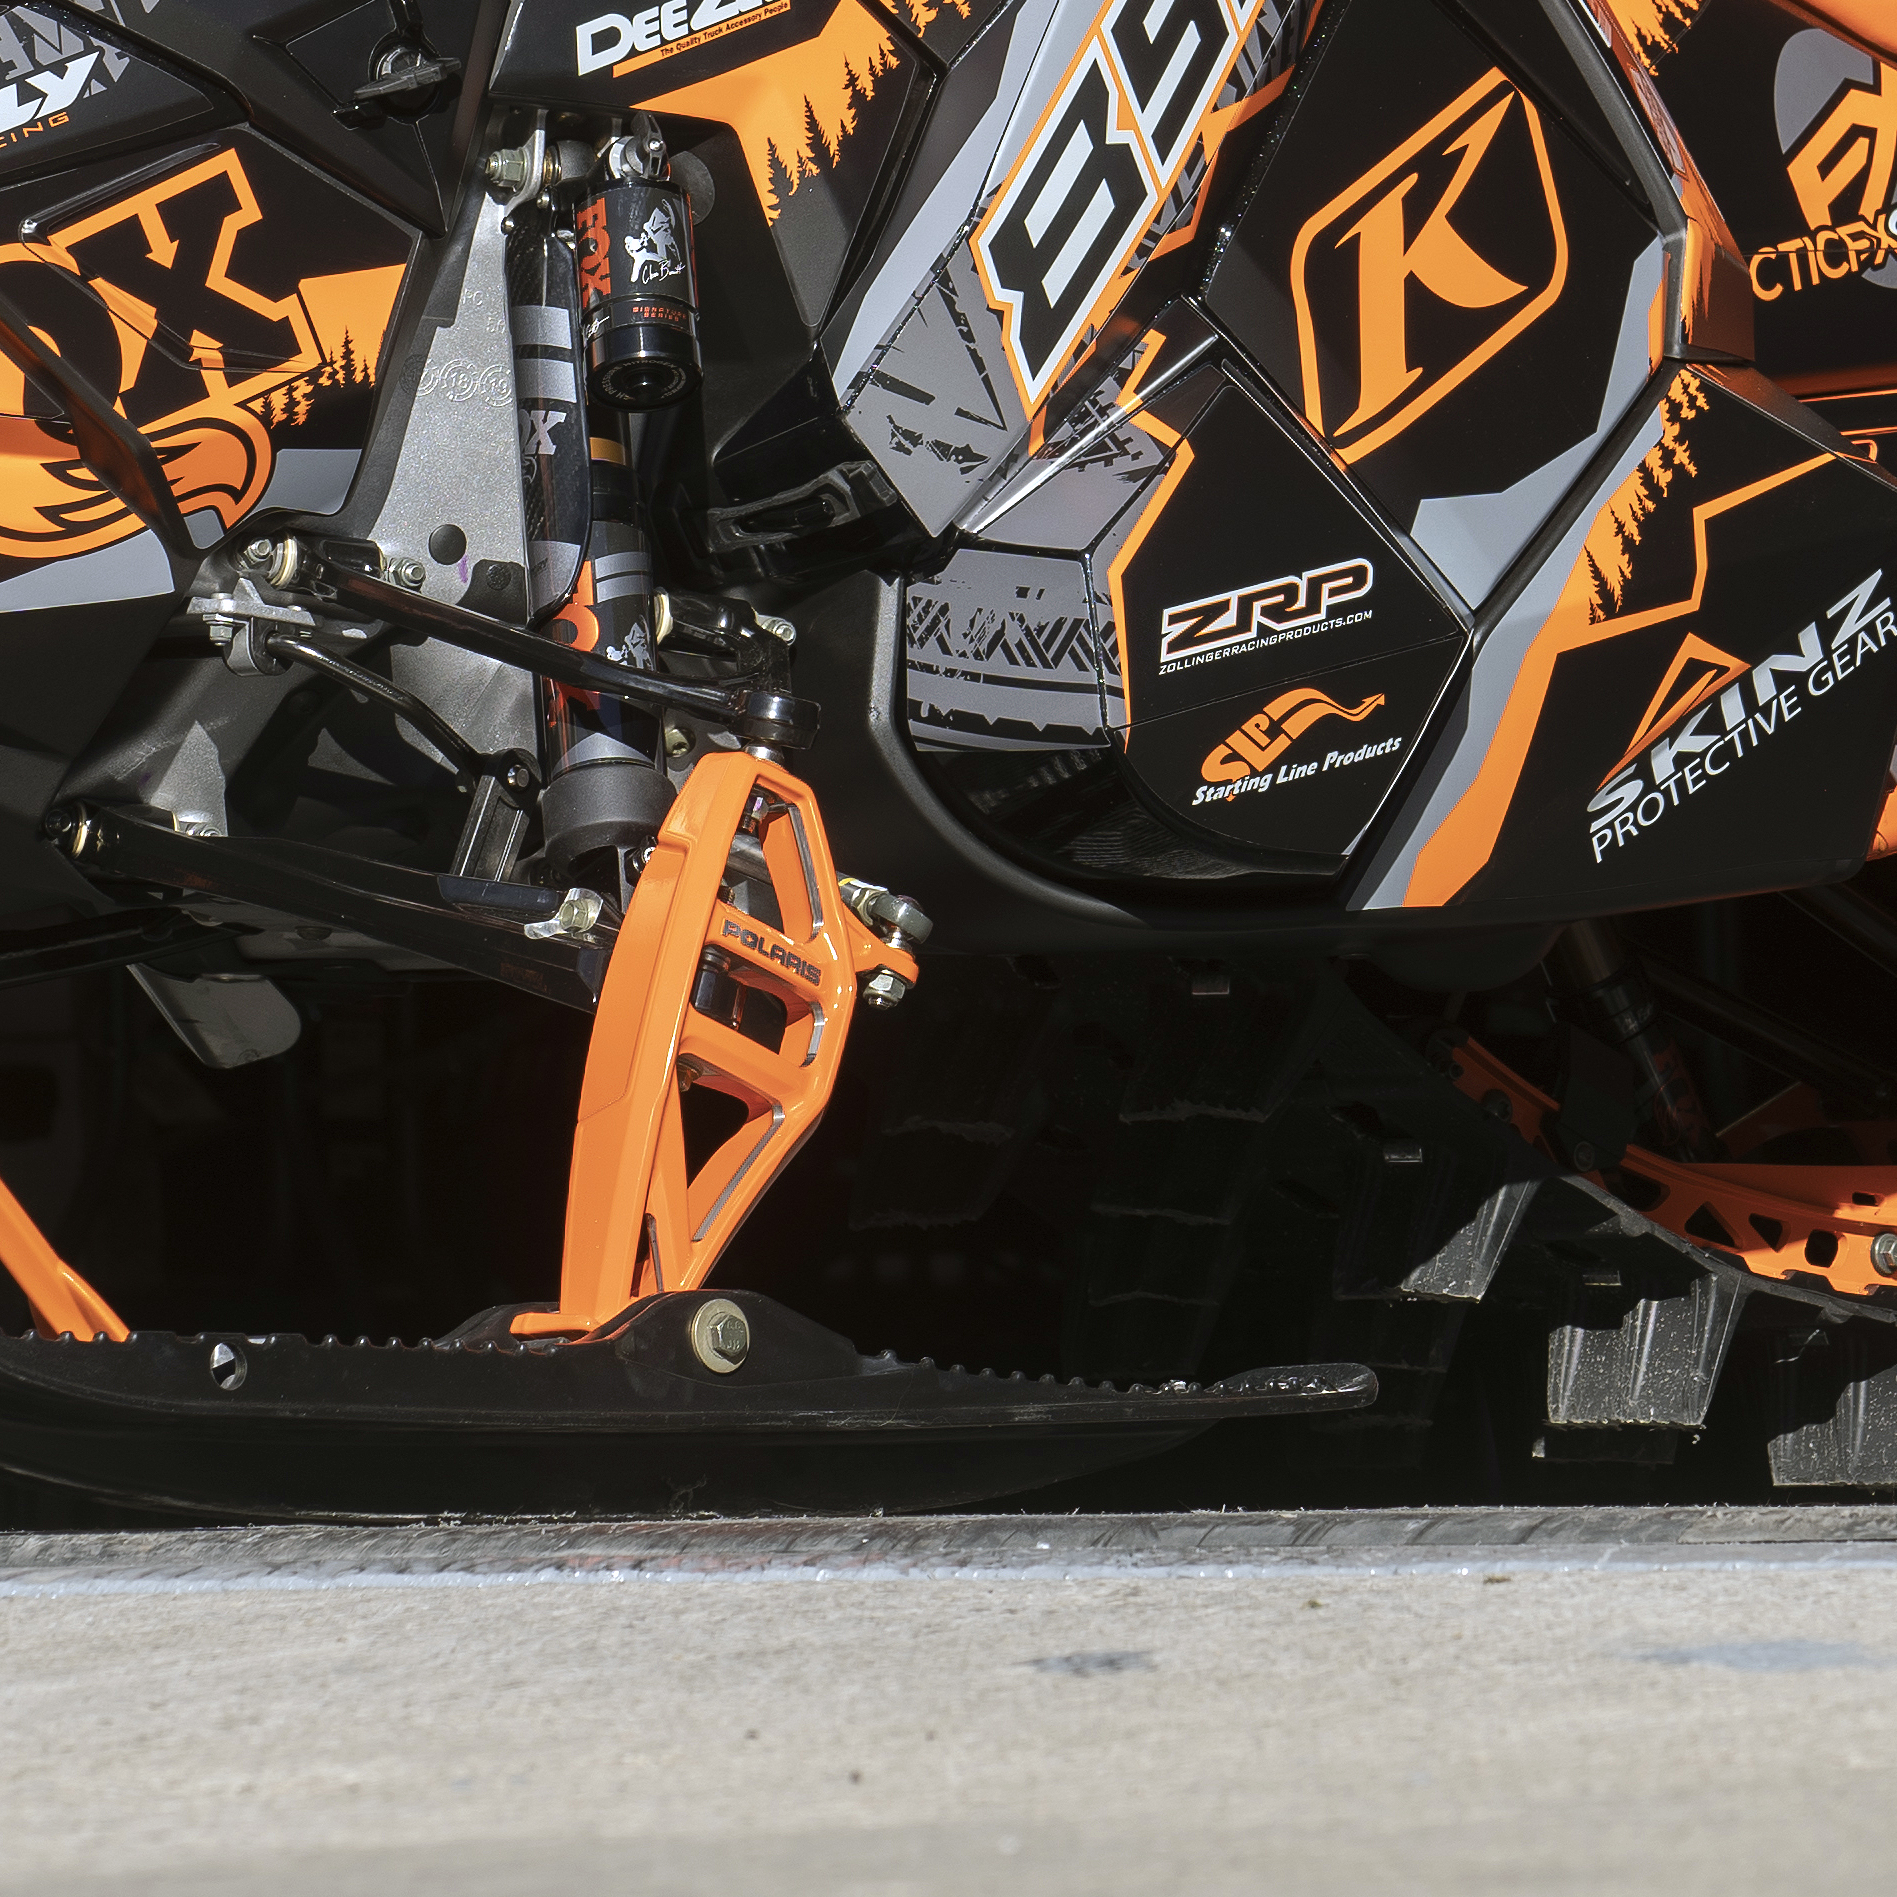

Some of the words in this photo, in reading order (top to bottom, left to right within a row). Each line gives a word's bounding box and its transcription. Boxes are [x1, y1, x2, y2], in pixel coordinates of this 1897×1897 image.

[660, 47, 674, 57] The
[676, 35, 702, 51] Quality
[703, 26, 724, 41] Truck
[725, 11, 763, 32] Accessory
[1157, 609, 1375, 677] ZOLLINGERRACINGPRODUCTS.COM
[1159, 556, 1375, 664] ZRP
[1586, 567, 1894, 835] SKINZ
[1191, 771, 1275, 806] Starting
[1276, 763, 1318, 785] Line
[1321, 736, 1403, 773] Products
[1589, 684, 1803, 865] PROTECTIVE
[720, 918, 823, 987] POLARIS
